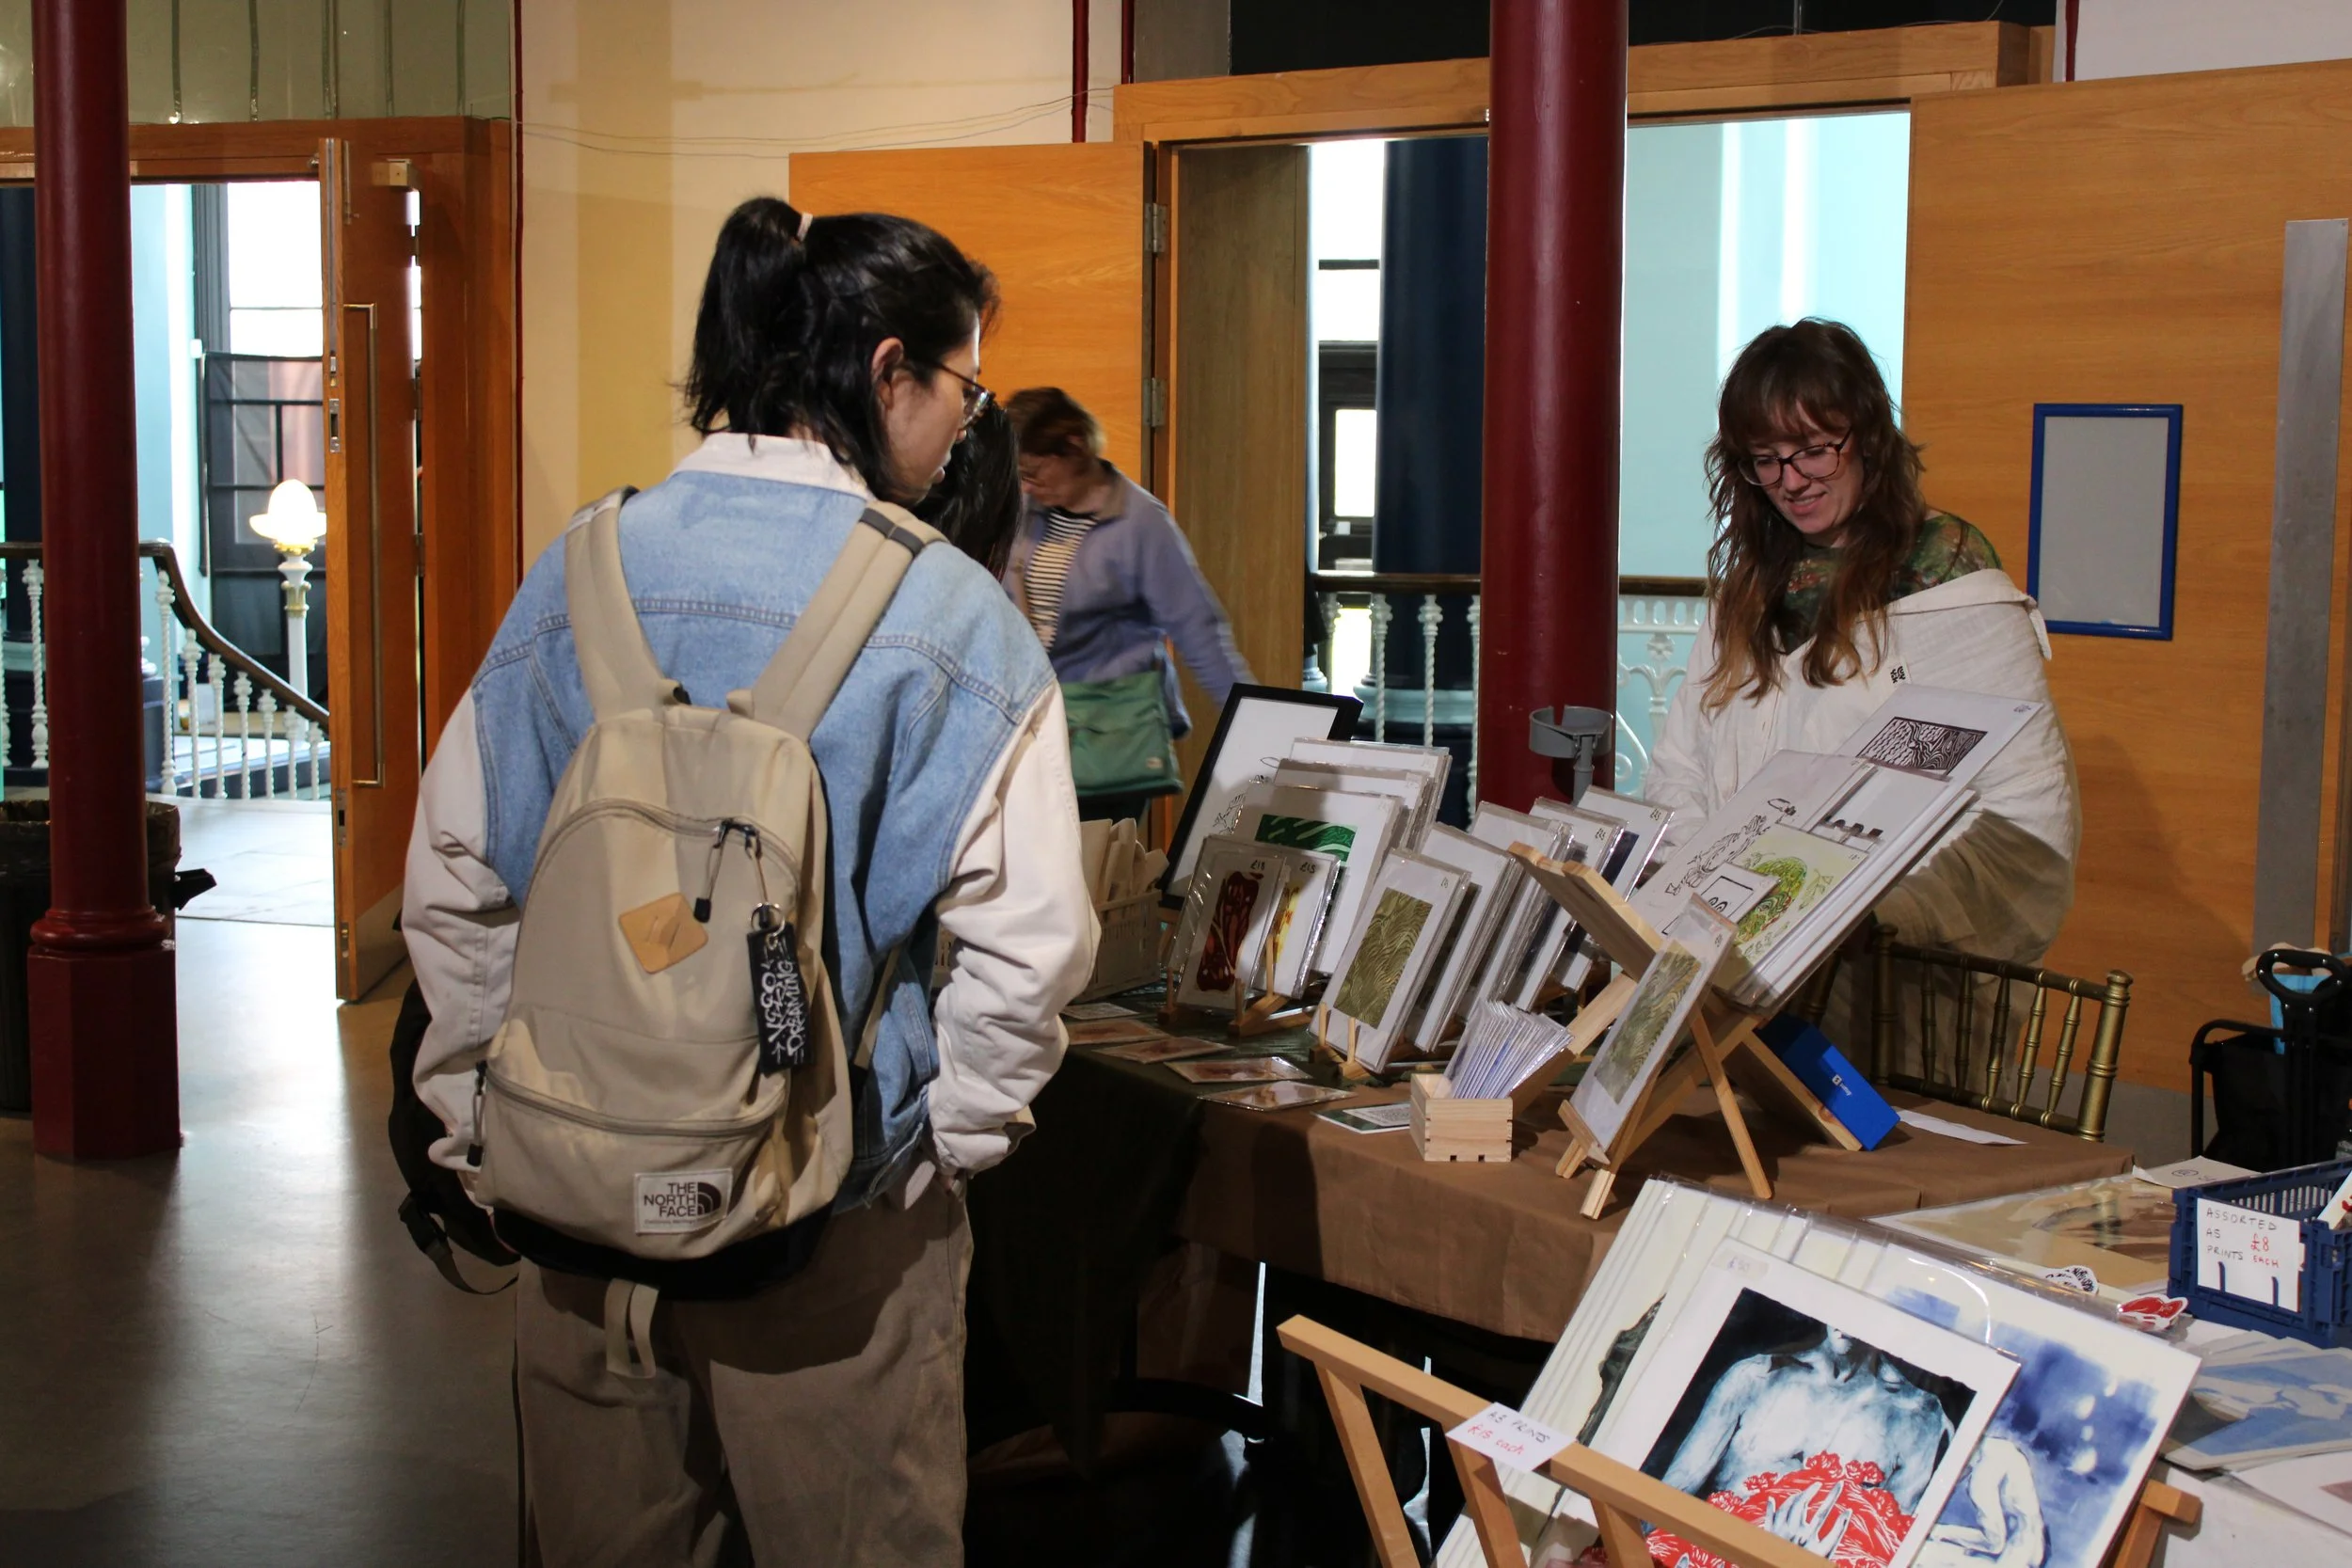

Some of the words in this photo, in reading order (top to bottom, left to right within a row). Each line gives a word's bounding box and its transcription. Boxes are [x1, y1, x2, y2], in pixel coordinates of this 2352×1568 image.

[667, 1181, 696, 1194] THE
[644, 1194, 696, 1206] NORTH
[658, 1205, 696, 1217] FACE
[2206, 1207, 2278, 1230] ASSORTED
[2250, 1233, 2270, 1252] £8
[2206, 1244, 2244, 1260] PRINTS
[2253, 1255, 2280, 1268] EACH
